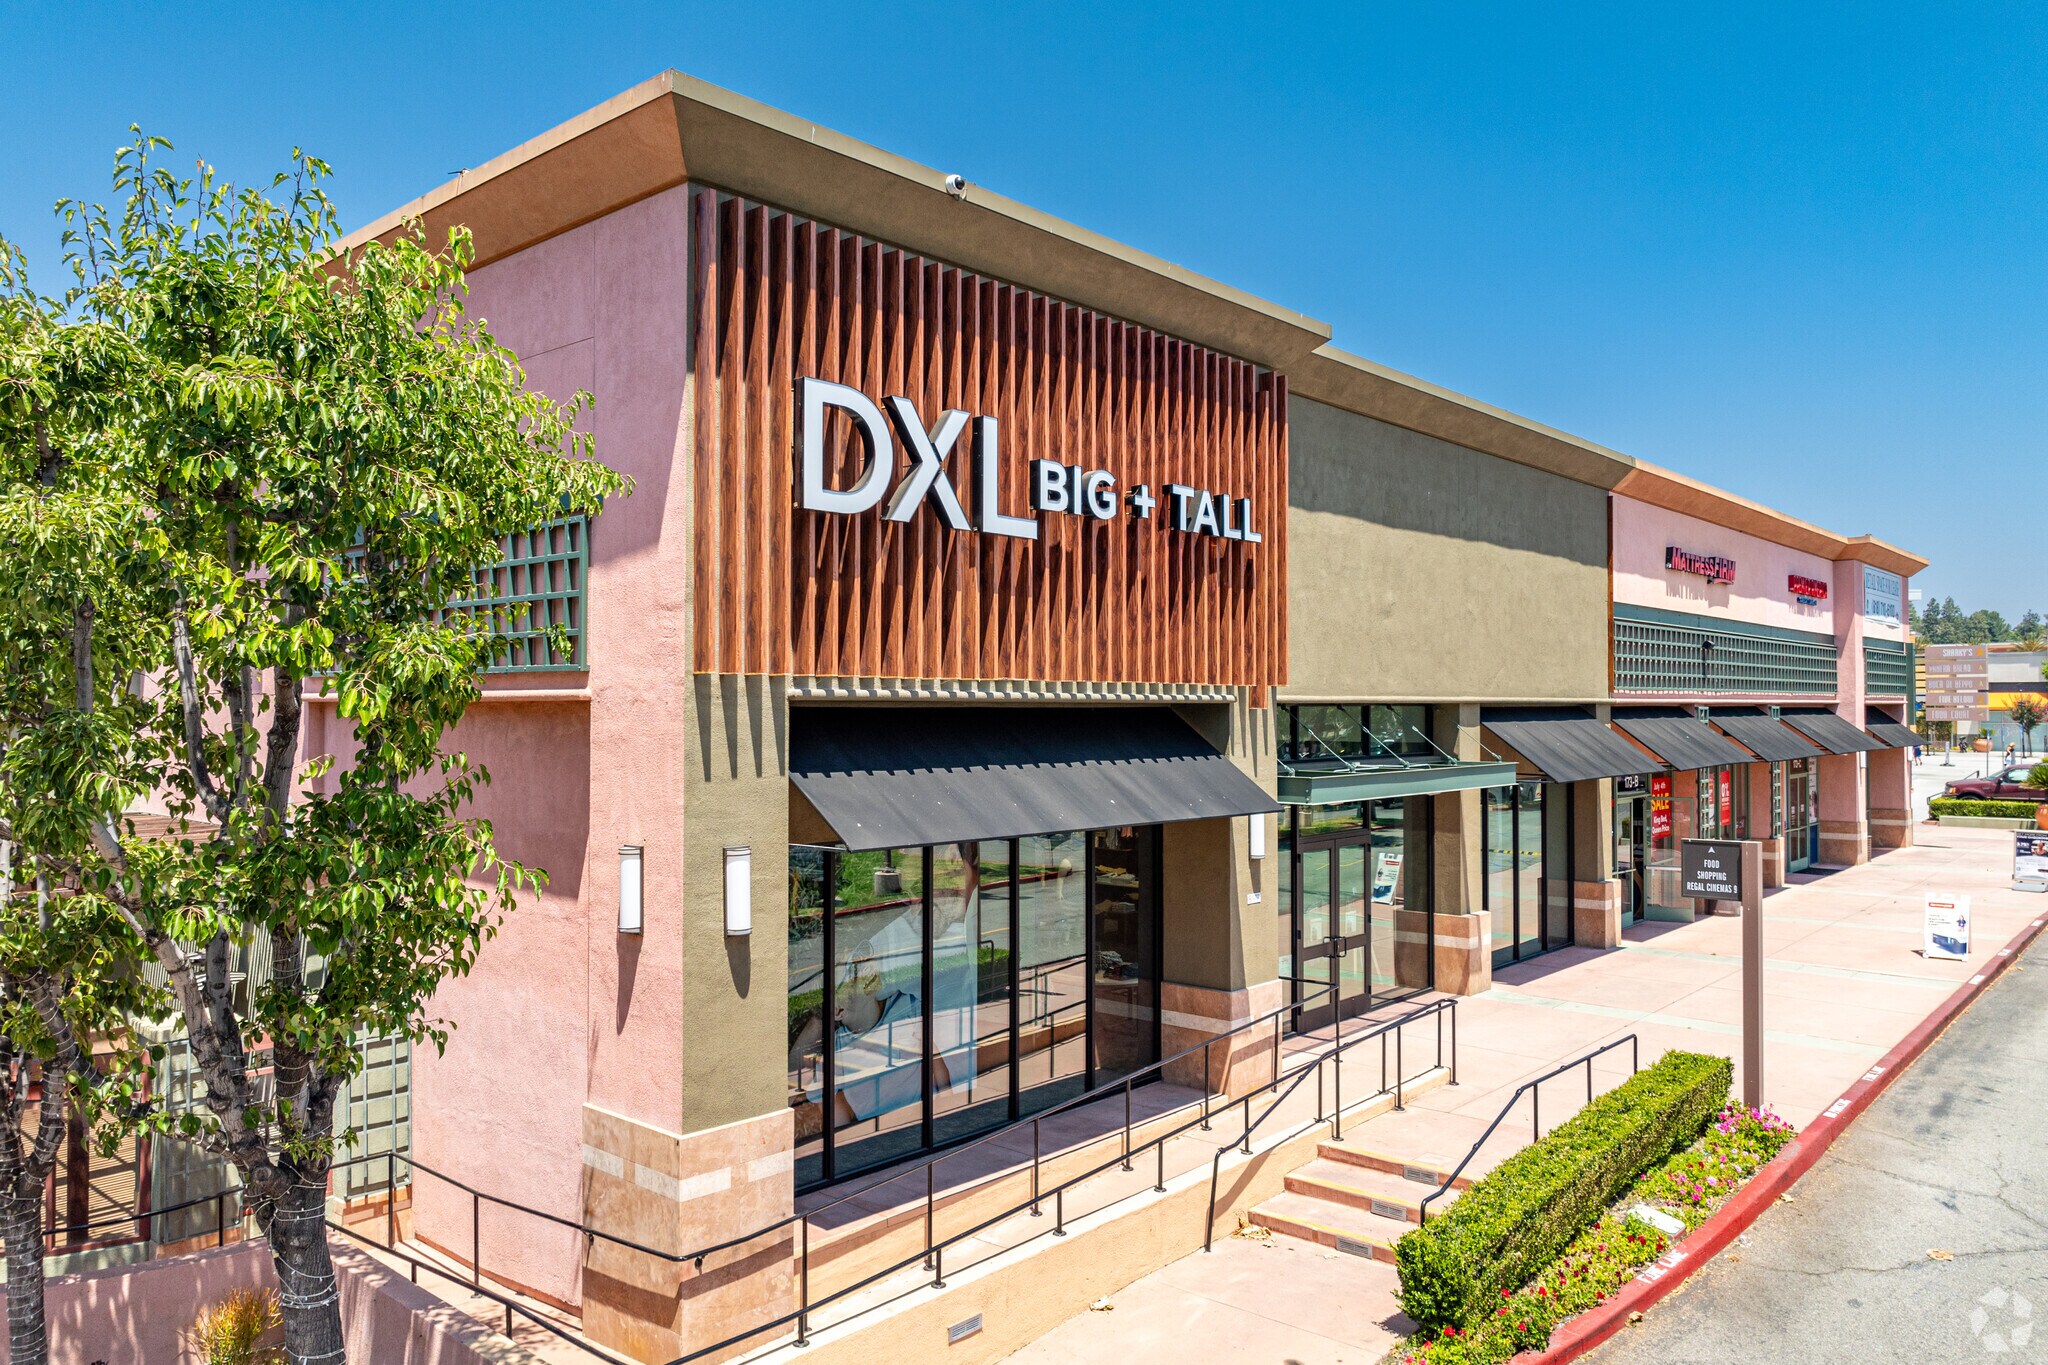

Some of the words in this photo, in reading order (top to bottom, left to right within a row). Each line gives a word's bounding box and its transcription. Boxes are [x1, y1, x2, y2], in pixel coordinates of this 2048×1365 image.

[794, 376, 1038, 540] DXL
[1030, 458, 1117, 520] BIG
[1132, 484, 1156, 519] +
[1163, 483, 1262, 543] TALL
[1942, 648, 1973, 657] SHARKY'S
[1624, 775, 1639, 789] 173-B
[1651, 792, 1670, 811] SALE
[1703, 859, 1720, 869] FOOD
[1696, 870, 1727, 881] SHOPPING
[1686, 881, 1706, 892] REGAL
[1706, 882, 1732, 893] CINEMAS
[1733, 885, 1738, 894] 9
